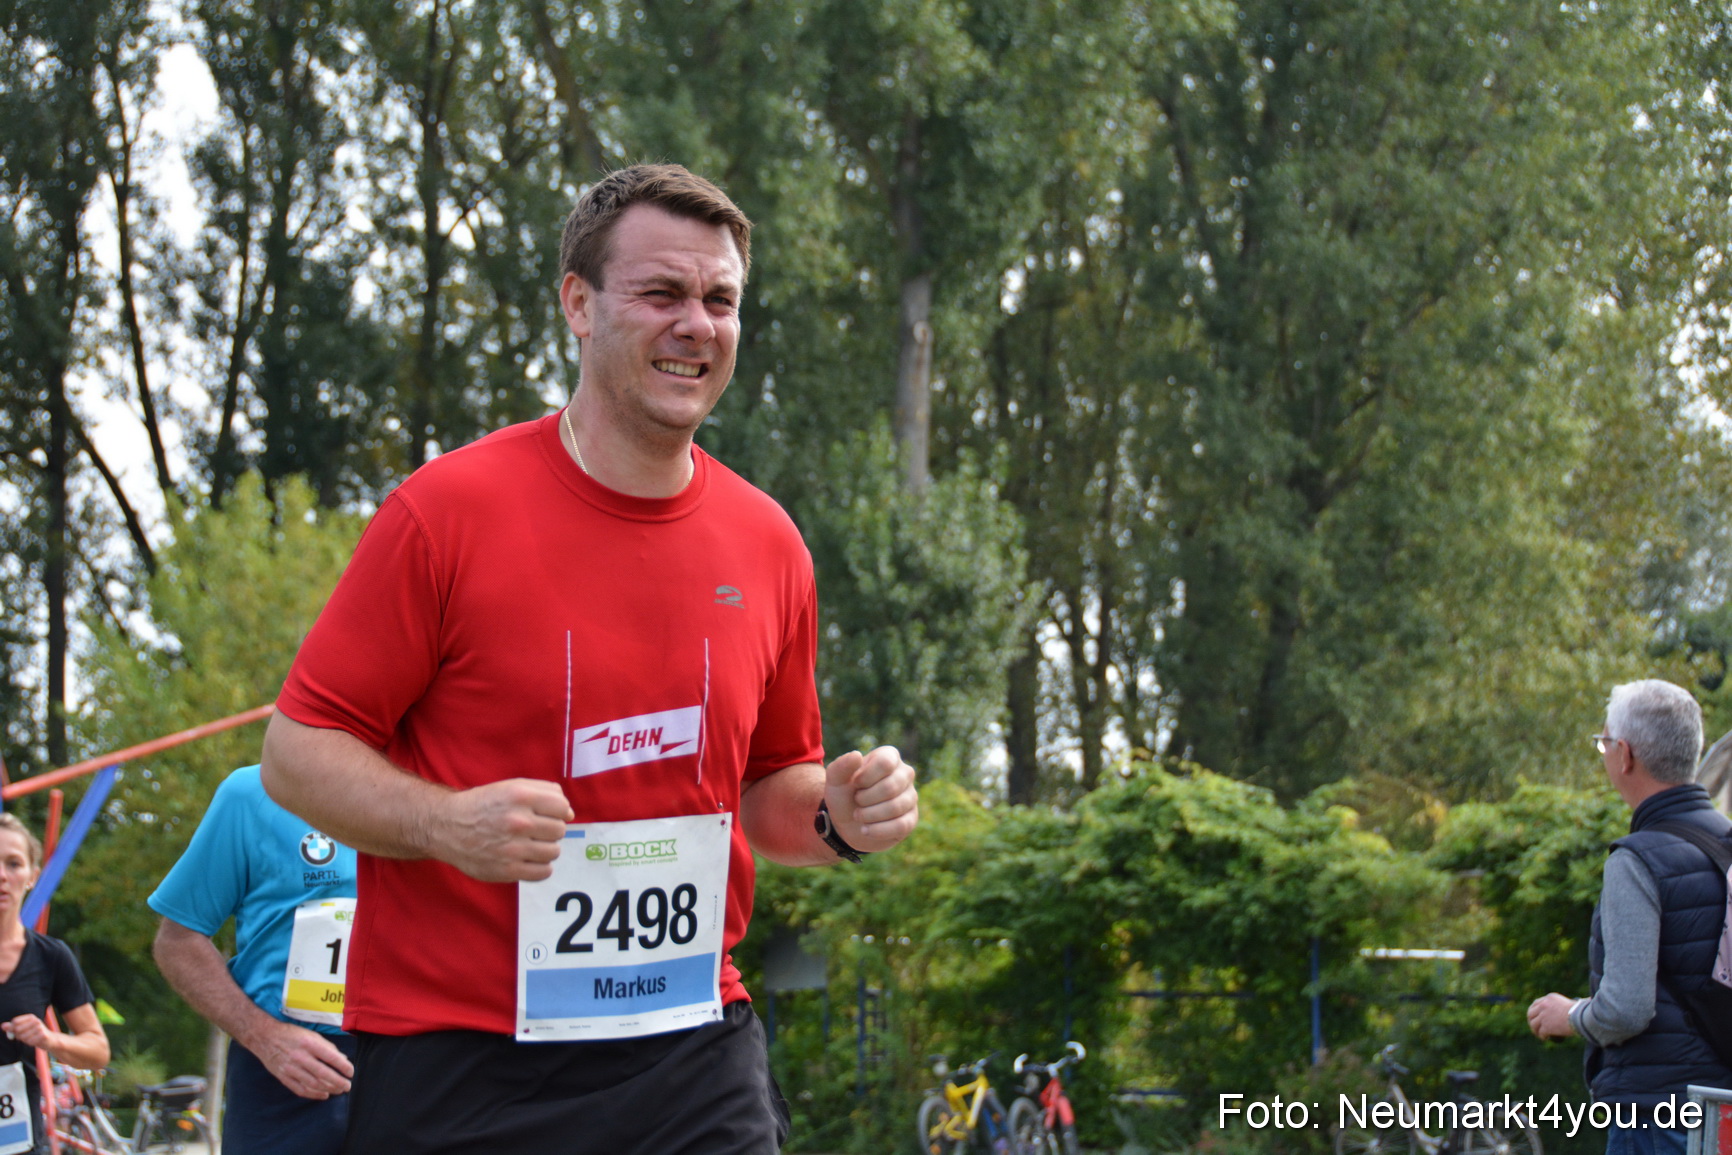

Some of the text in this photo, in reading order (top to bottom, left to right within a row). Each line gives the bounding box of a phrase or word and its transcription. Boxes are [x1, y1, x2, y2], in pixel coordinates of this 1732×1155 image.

[607, 727, 663, 755] DEHN
[609, 839, 677, 860] BOCK
[303, 870, 340, 881] PARTL
[554, 883, 698, 954] 2498
[532, 948, 541, 960] D
[594, 976, 667, 1000] Markus
